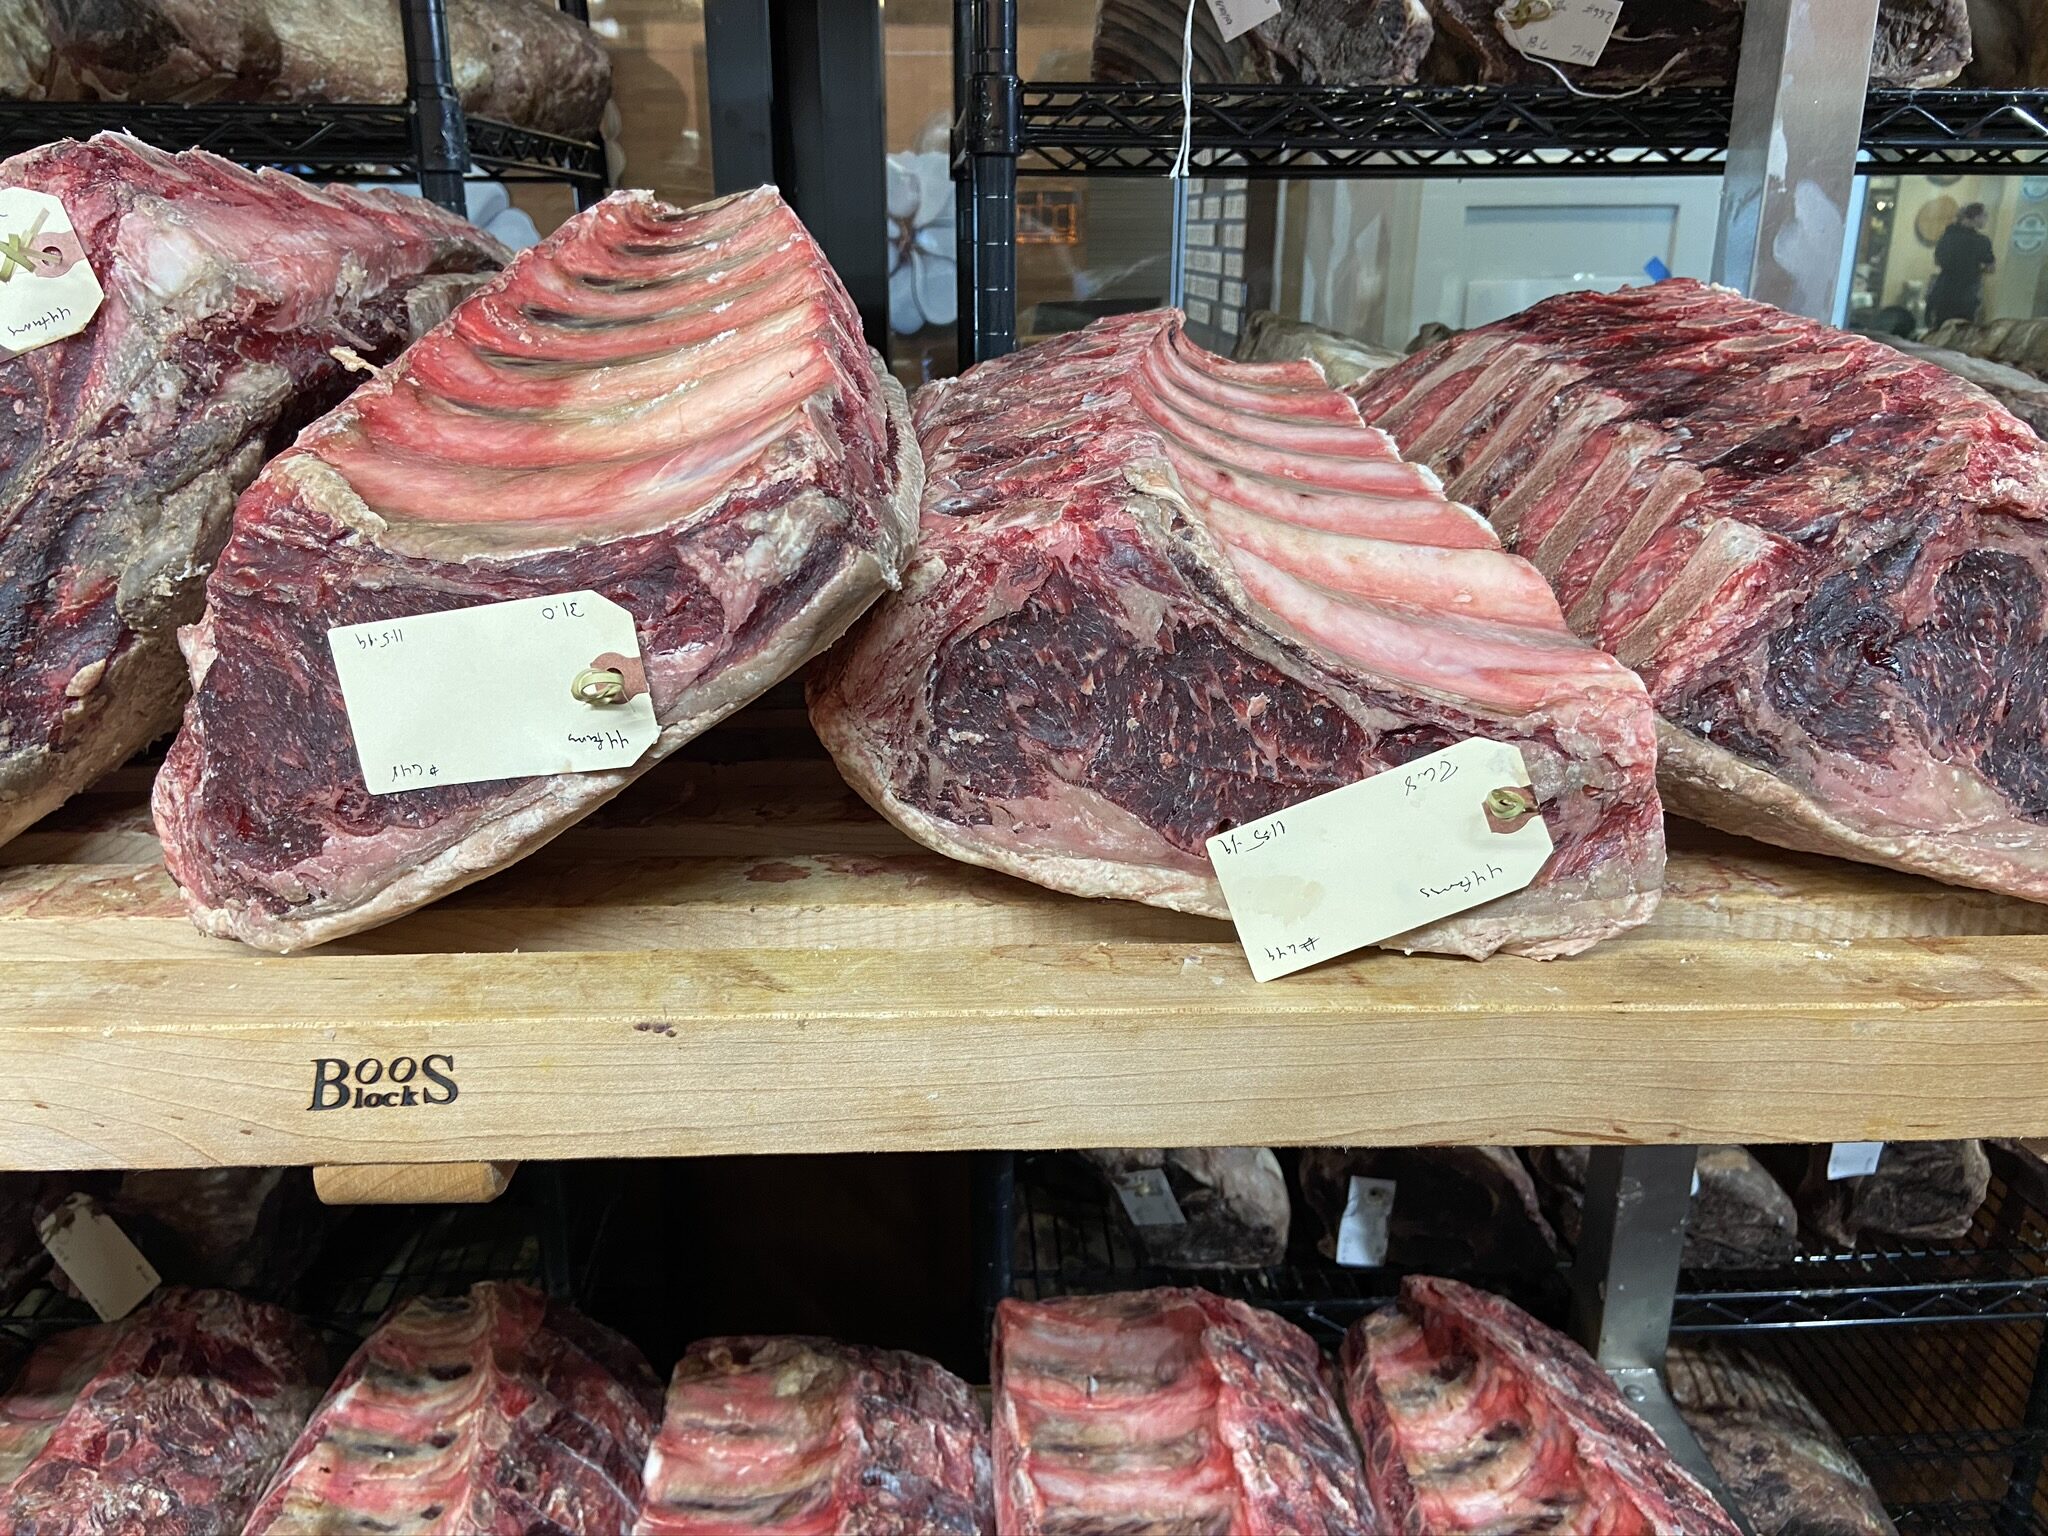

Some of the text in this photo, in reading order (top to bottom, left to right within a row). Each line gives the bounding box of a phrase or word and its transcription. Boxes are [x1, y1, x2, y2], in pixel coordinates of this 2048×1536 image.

[541, 601, 585, 620] 31.0
[605, 729, 630, 750] 44
[1472, 863, 1503, 886] 44
